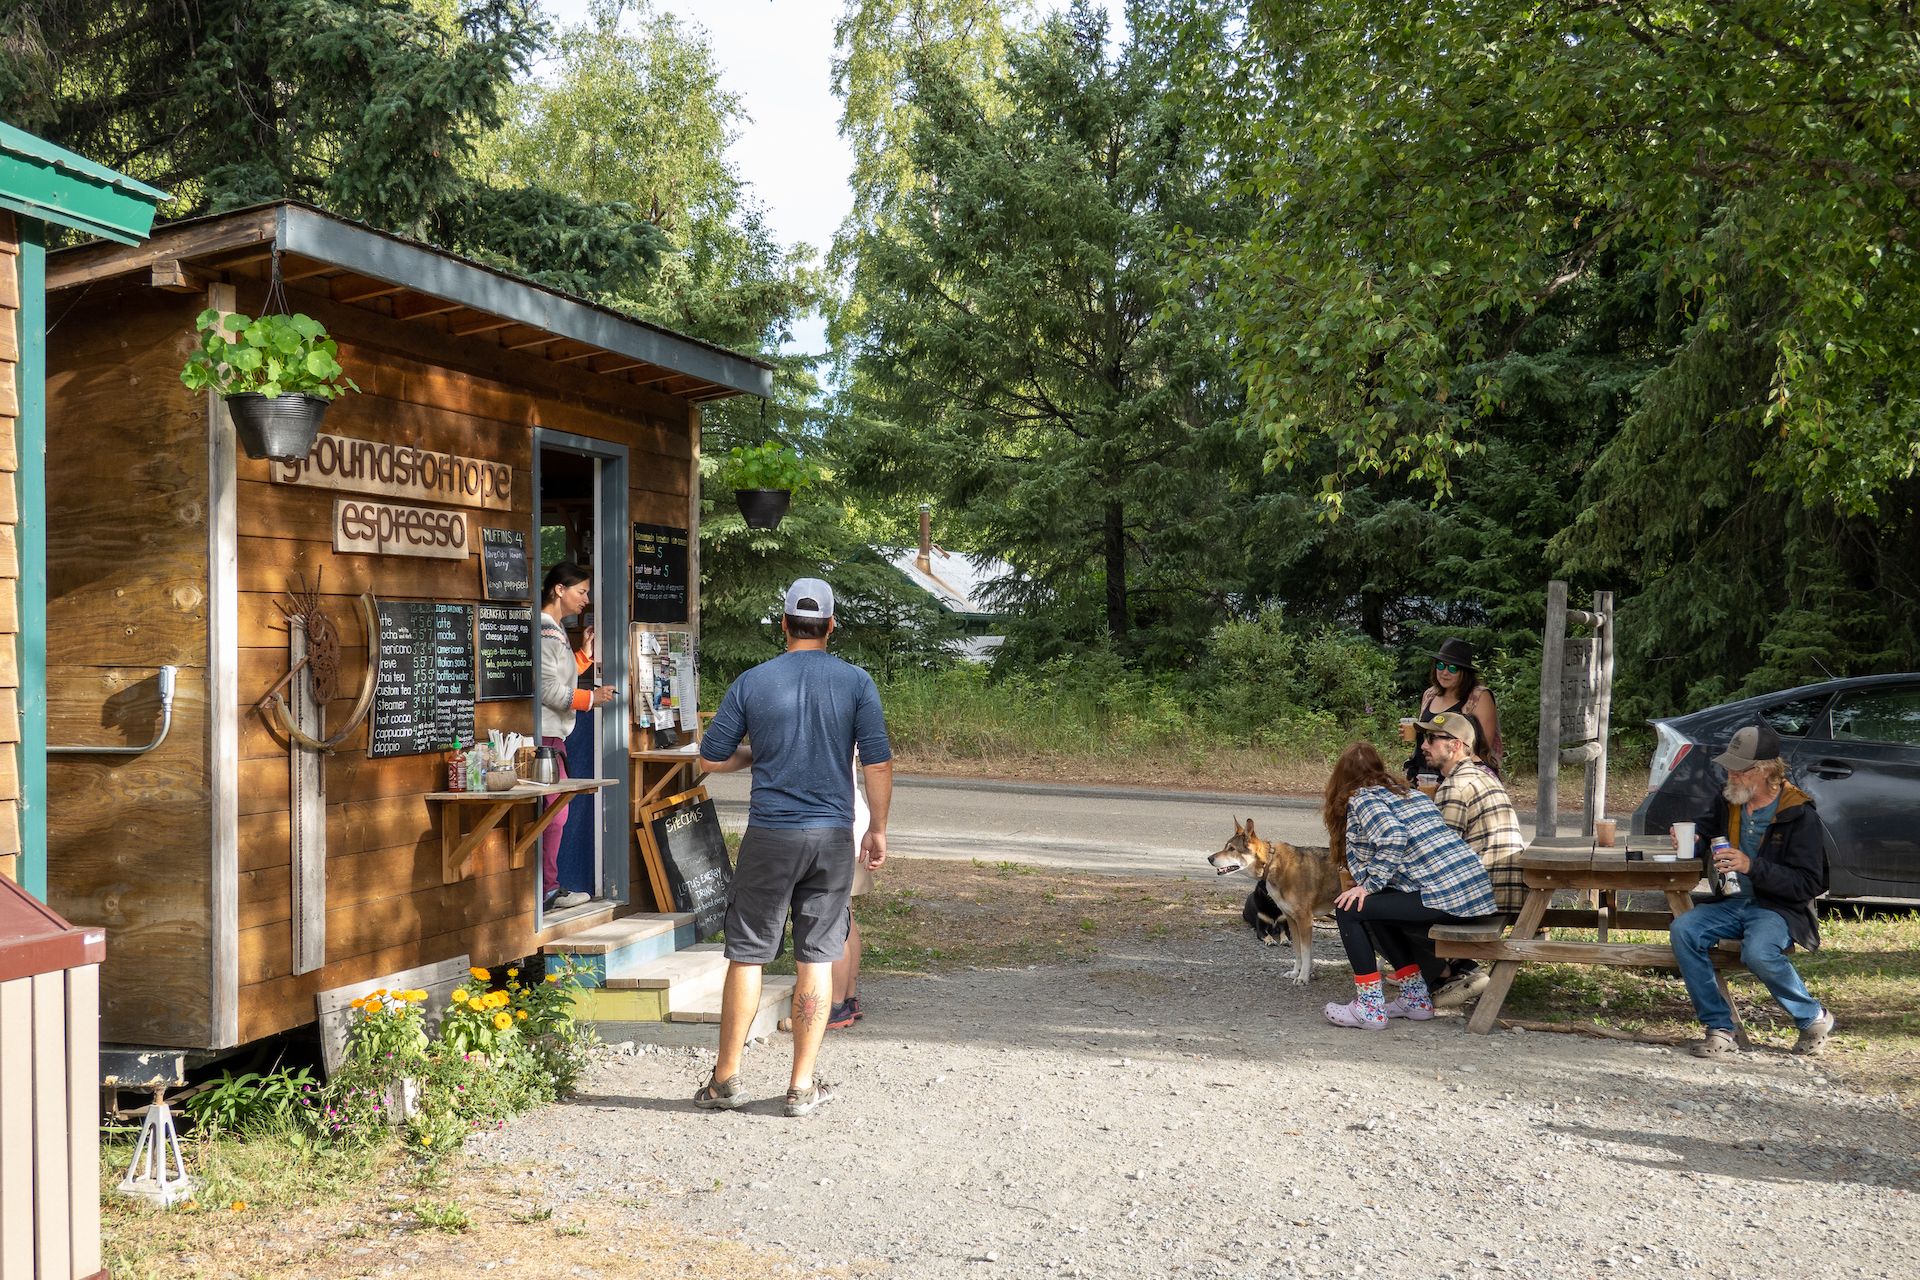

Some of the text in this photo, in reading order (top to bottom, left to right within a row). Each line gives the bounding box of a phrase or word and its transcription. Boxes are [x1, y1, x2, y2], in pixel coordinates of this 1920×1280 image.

[341, 503, 466, 554] espresso
[483, 528, 513, 544] MUFFINS
[656, 546, 663, 558] 5
[663, 564, 670, 577] 5
[480, 608, 508, 620] BREAKFAST
[437, 616, 452, 629] latte
[381, 628, 398, 640] ocha
[437, 627, 473, 641] mocha 6
[503, 629, 519, 644] potato
[381, 643, 412, 655] mericano
[437, 644, 465, 655] americano
[380, 659, 397, 669] reve
[428, 656, 434, 668] 7
[454, 657, 467, 668] soda
[393, 671, 406, 682] tea
[486, 671, 506, 680] tomato
[376, 686, 400, 697] custom
[400, 684, 412, 695] tea
[437, 684, 449, 694] xtra
[449, 683, 462, 694] shot
[376, 698, 408, 711] steamer
[376, 712, 390, 725] hot
[391, 714, 412, 724] cocoa
[375, 726, 413, 741] cappuccino
[374, 740, 401, 756] doppio
